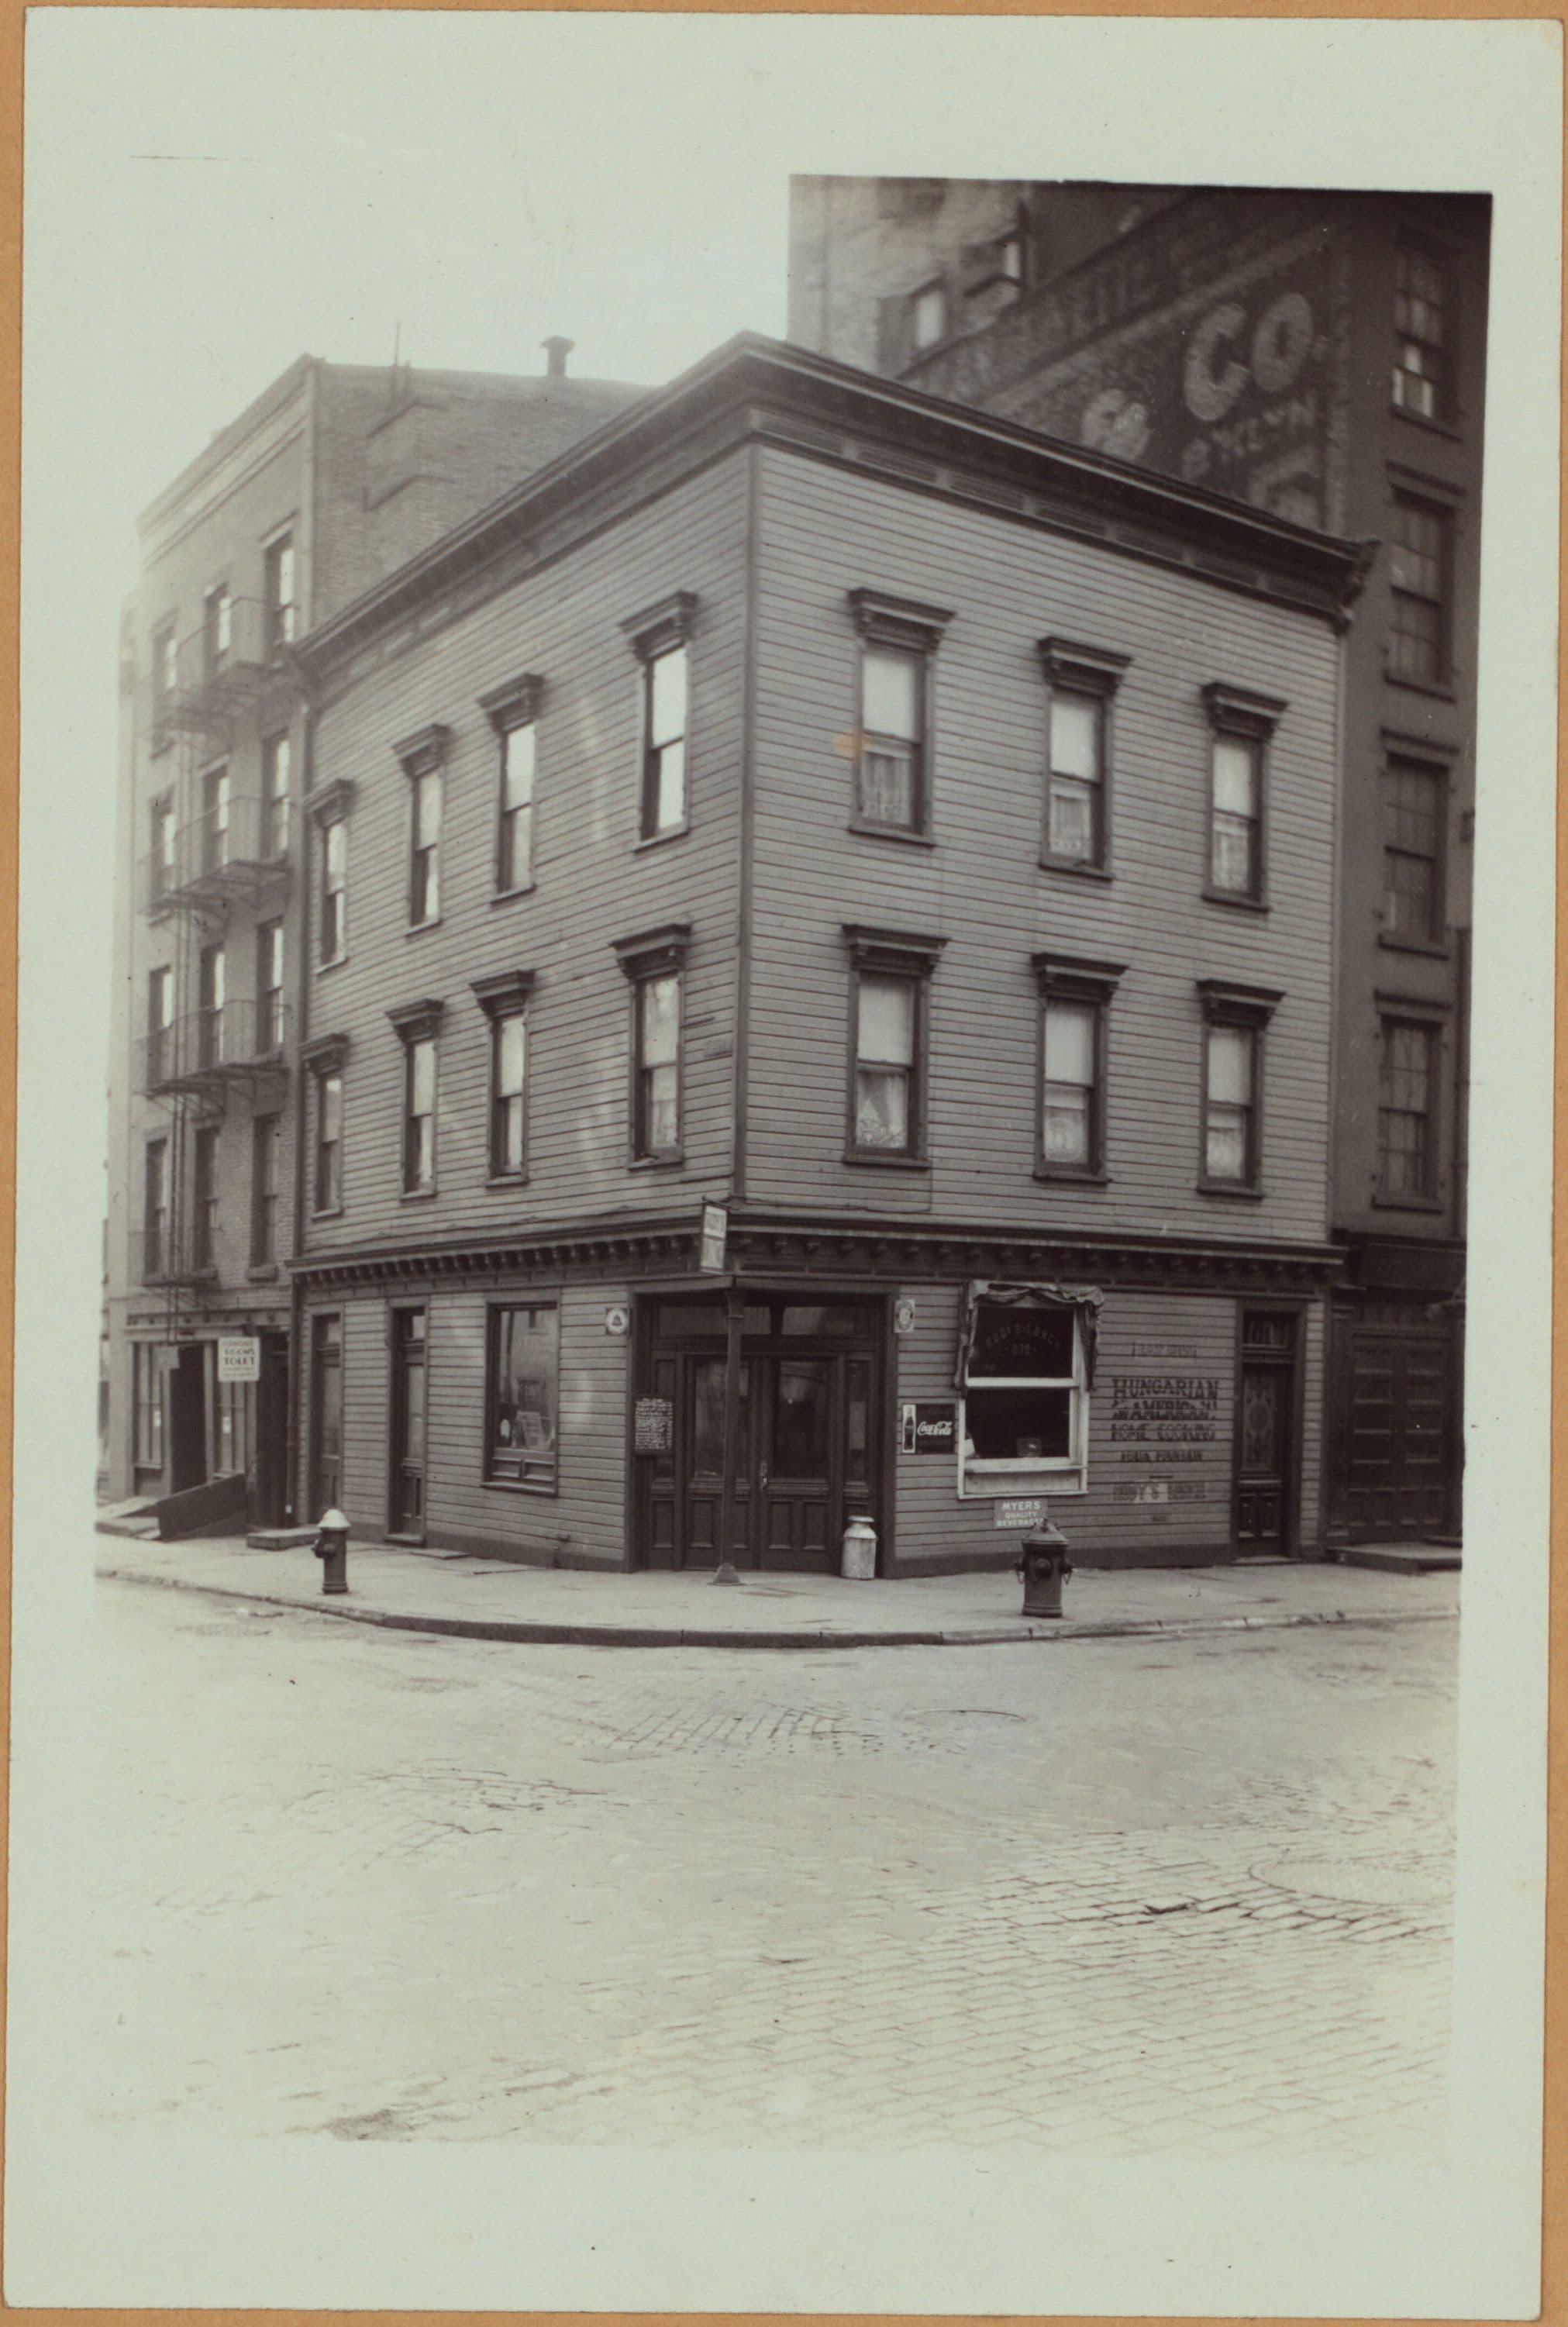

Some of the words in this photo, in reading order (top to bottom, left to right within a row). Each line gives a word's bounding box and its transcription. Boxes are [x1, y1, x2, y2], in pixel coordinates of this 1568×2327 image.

[1111, 1378, 1219, 1407] HUNGARIAN
[1157, 1423, 1216, 1441] COOKING
[1001, 1500, 1041, 1511] MYERS
